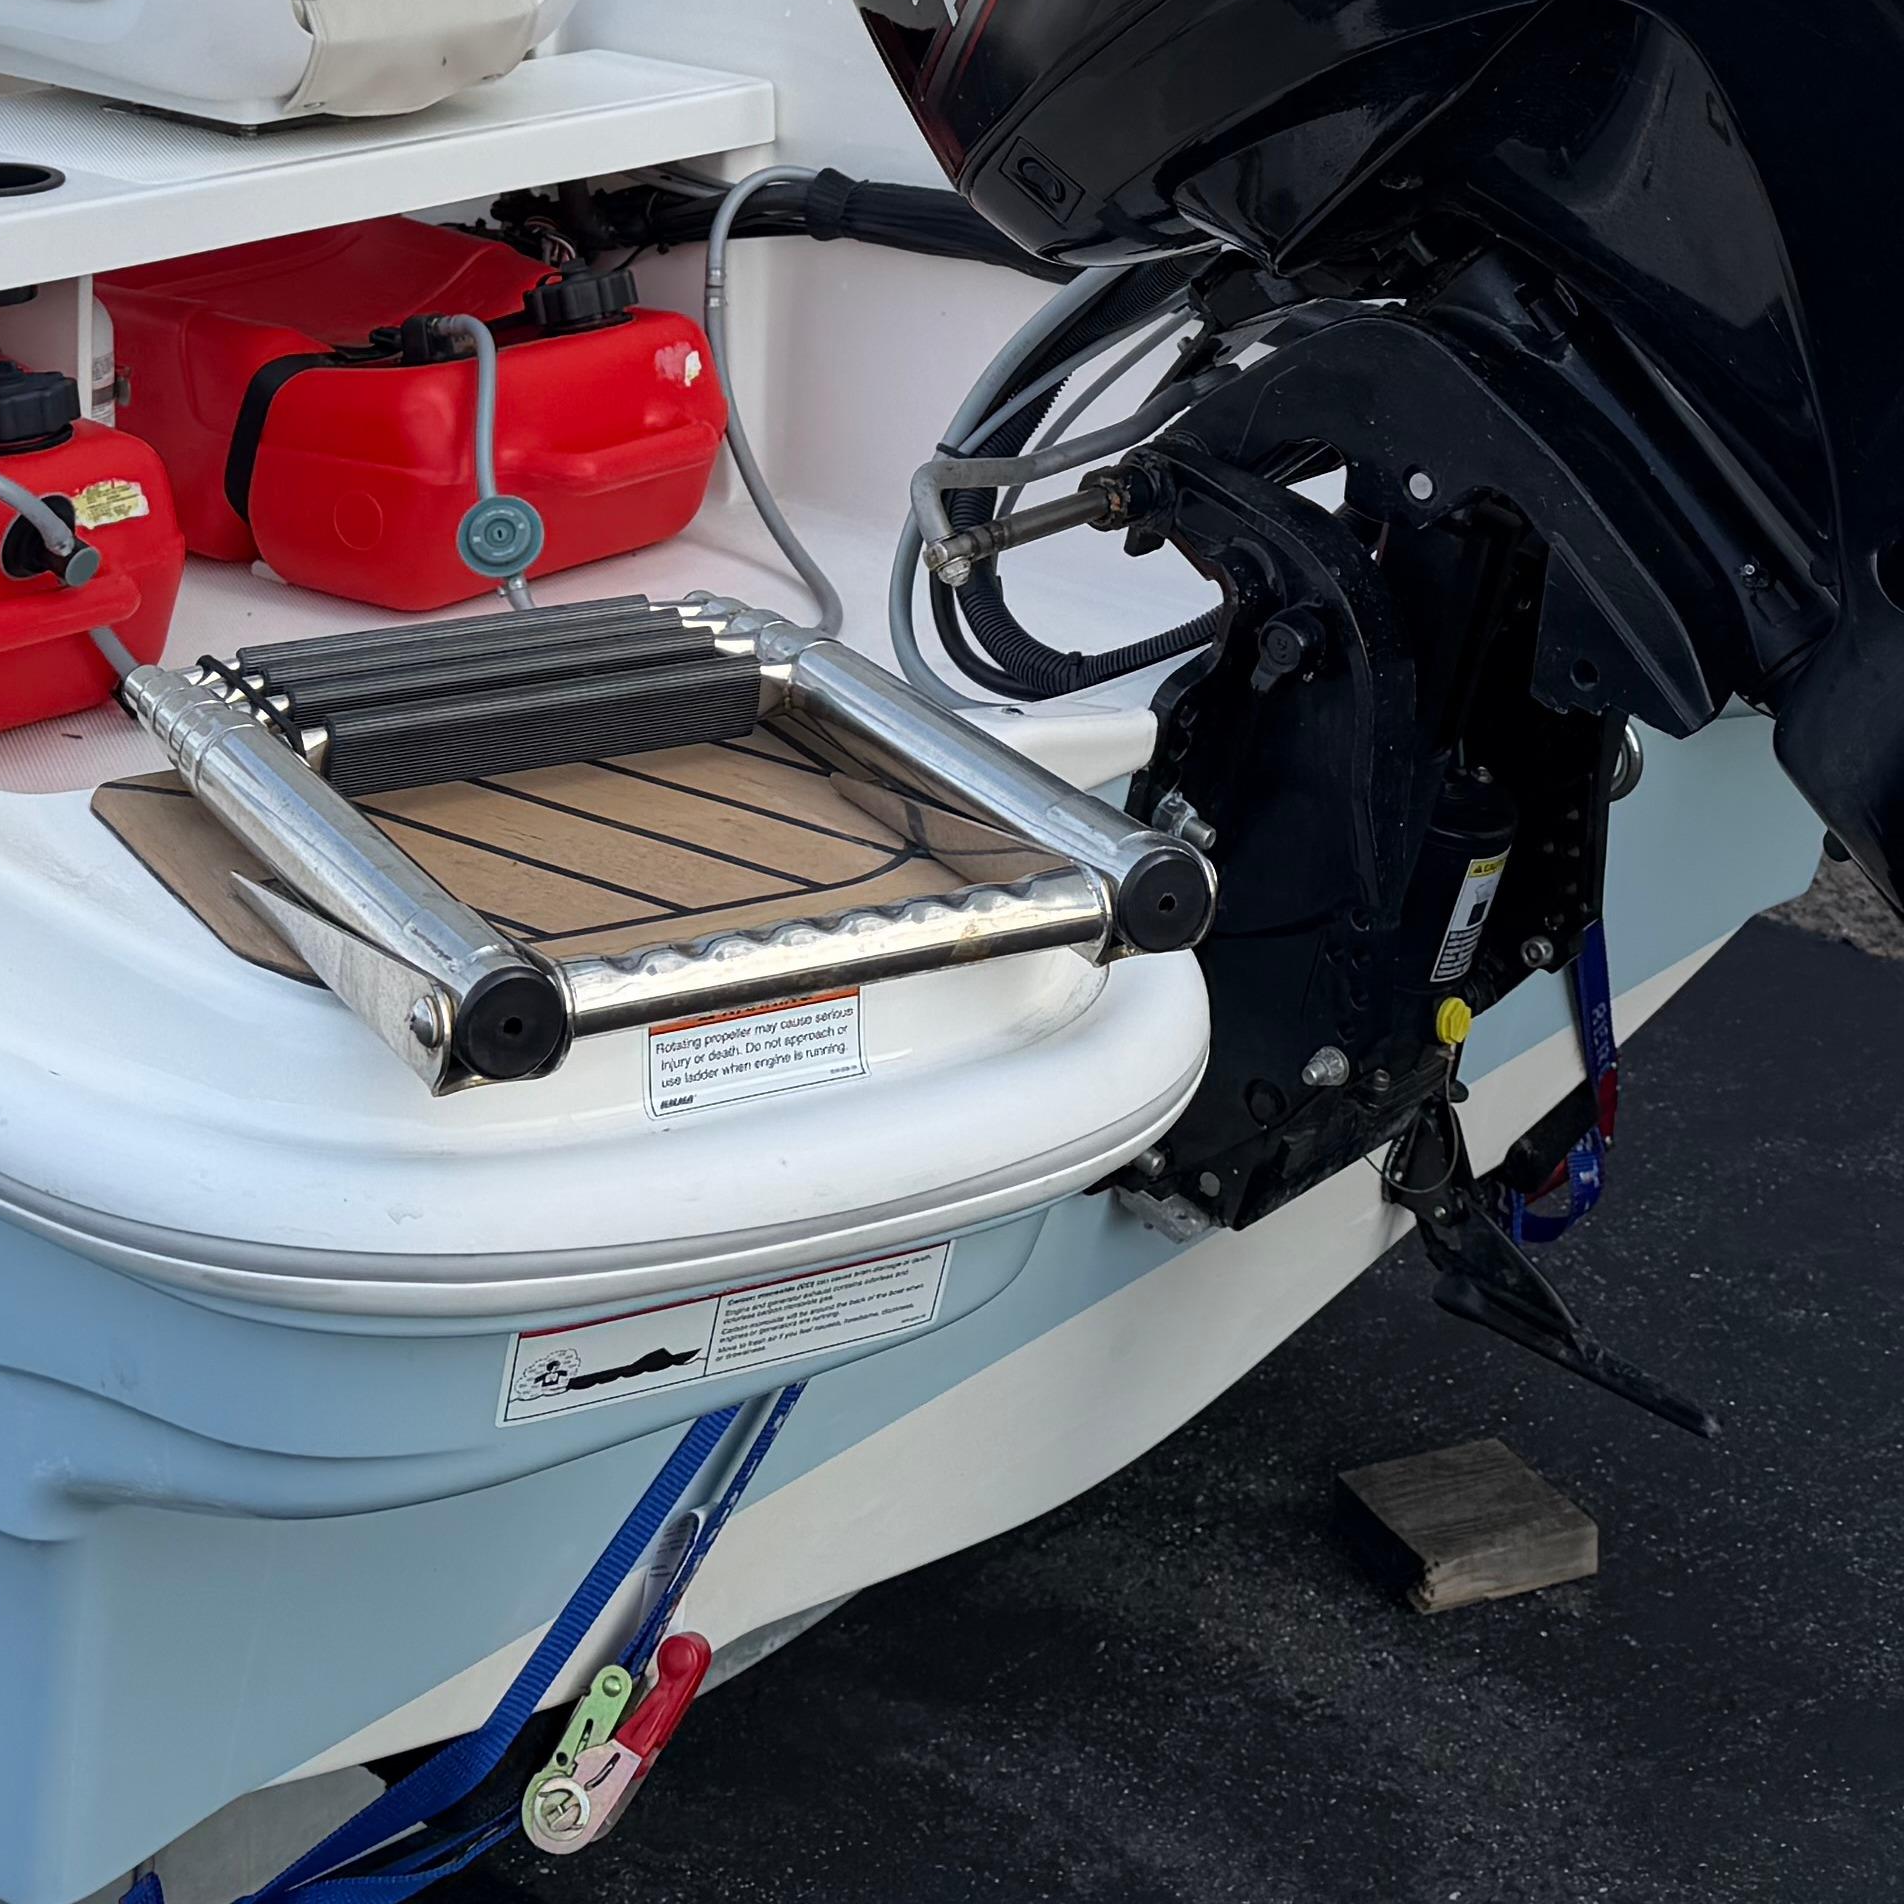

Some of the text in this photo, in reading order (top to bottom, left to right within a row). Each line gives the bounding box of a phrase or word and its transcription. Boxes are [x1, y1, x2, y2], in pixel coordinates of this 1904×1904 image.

[656, 1038, 702, 1054] Rotating
[705, 1027, 752, 1047] propeller
[755, 1022, 778, 1034] may
[780, 1016, 813, 1029] cause
[815, 1008, 853, 1023] serious
[694, 1054, 705, 1064] or
[708, 1046, 742, 1061] death.
[745, 1042, 762, 1054] Do
[764, 1037, 782, 1049] not
[785, 1026, 835, 1047] approach
[837, 1026, 848, 1035] or
[662, 1076, 681, 1088] use
[684, 1068, 718, 1083] ladder
[721, 1062, 751, 1075] when
[754, 1053, 791, 1069] engine
[794, 1050, 803, 1061] is
